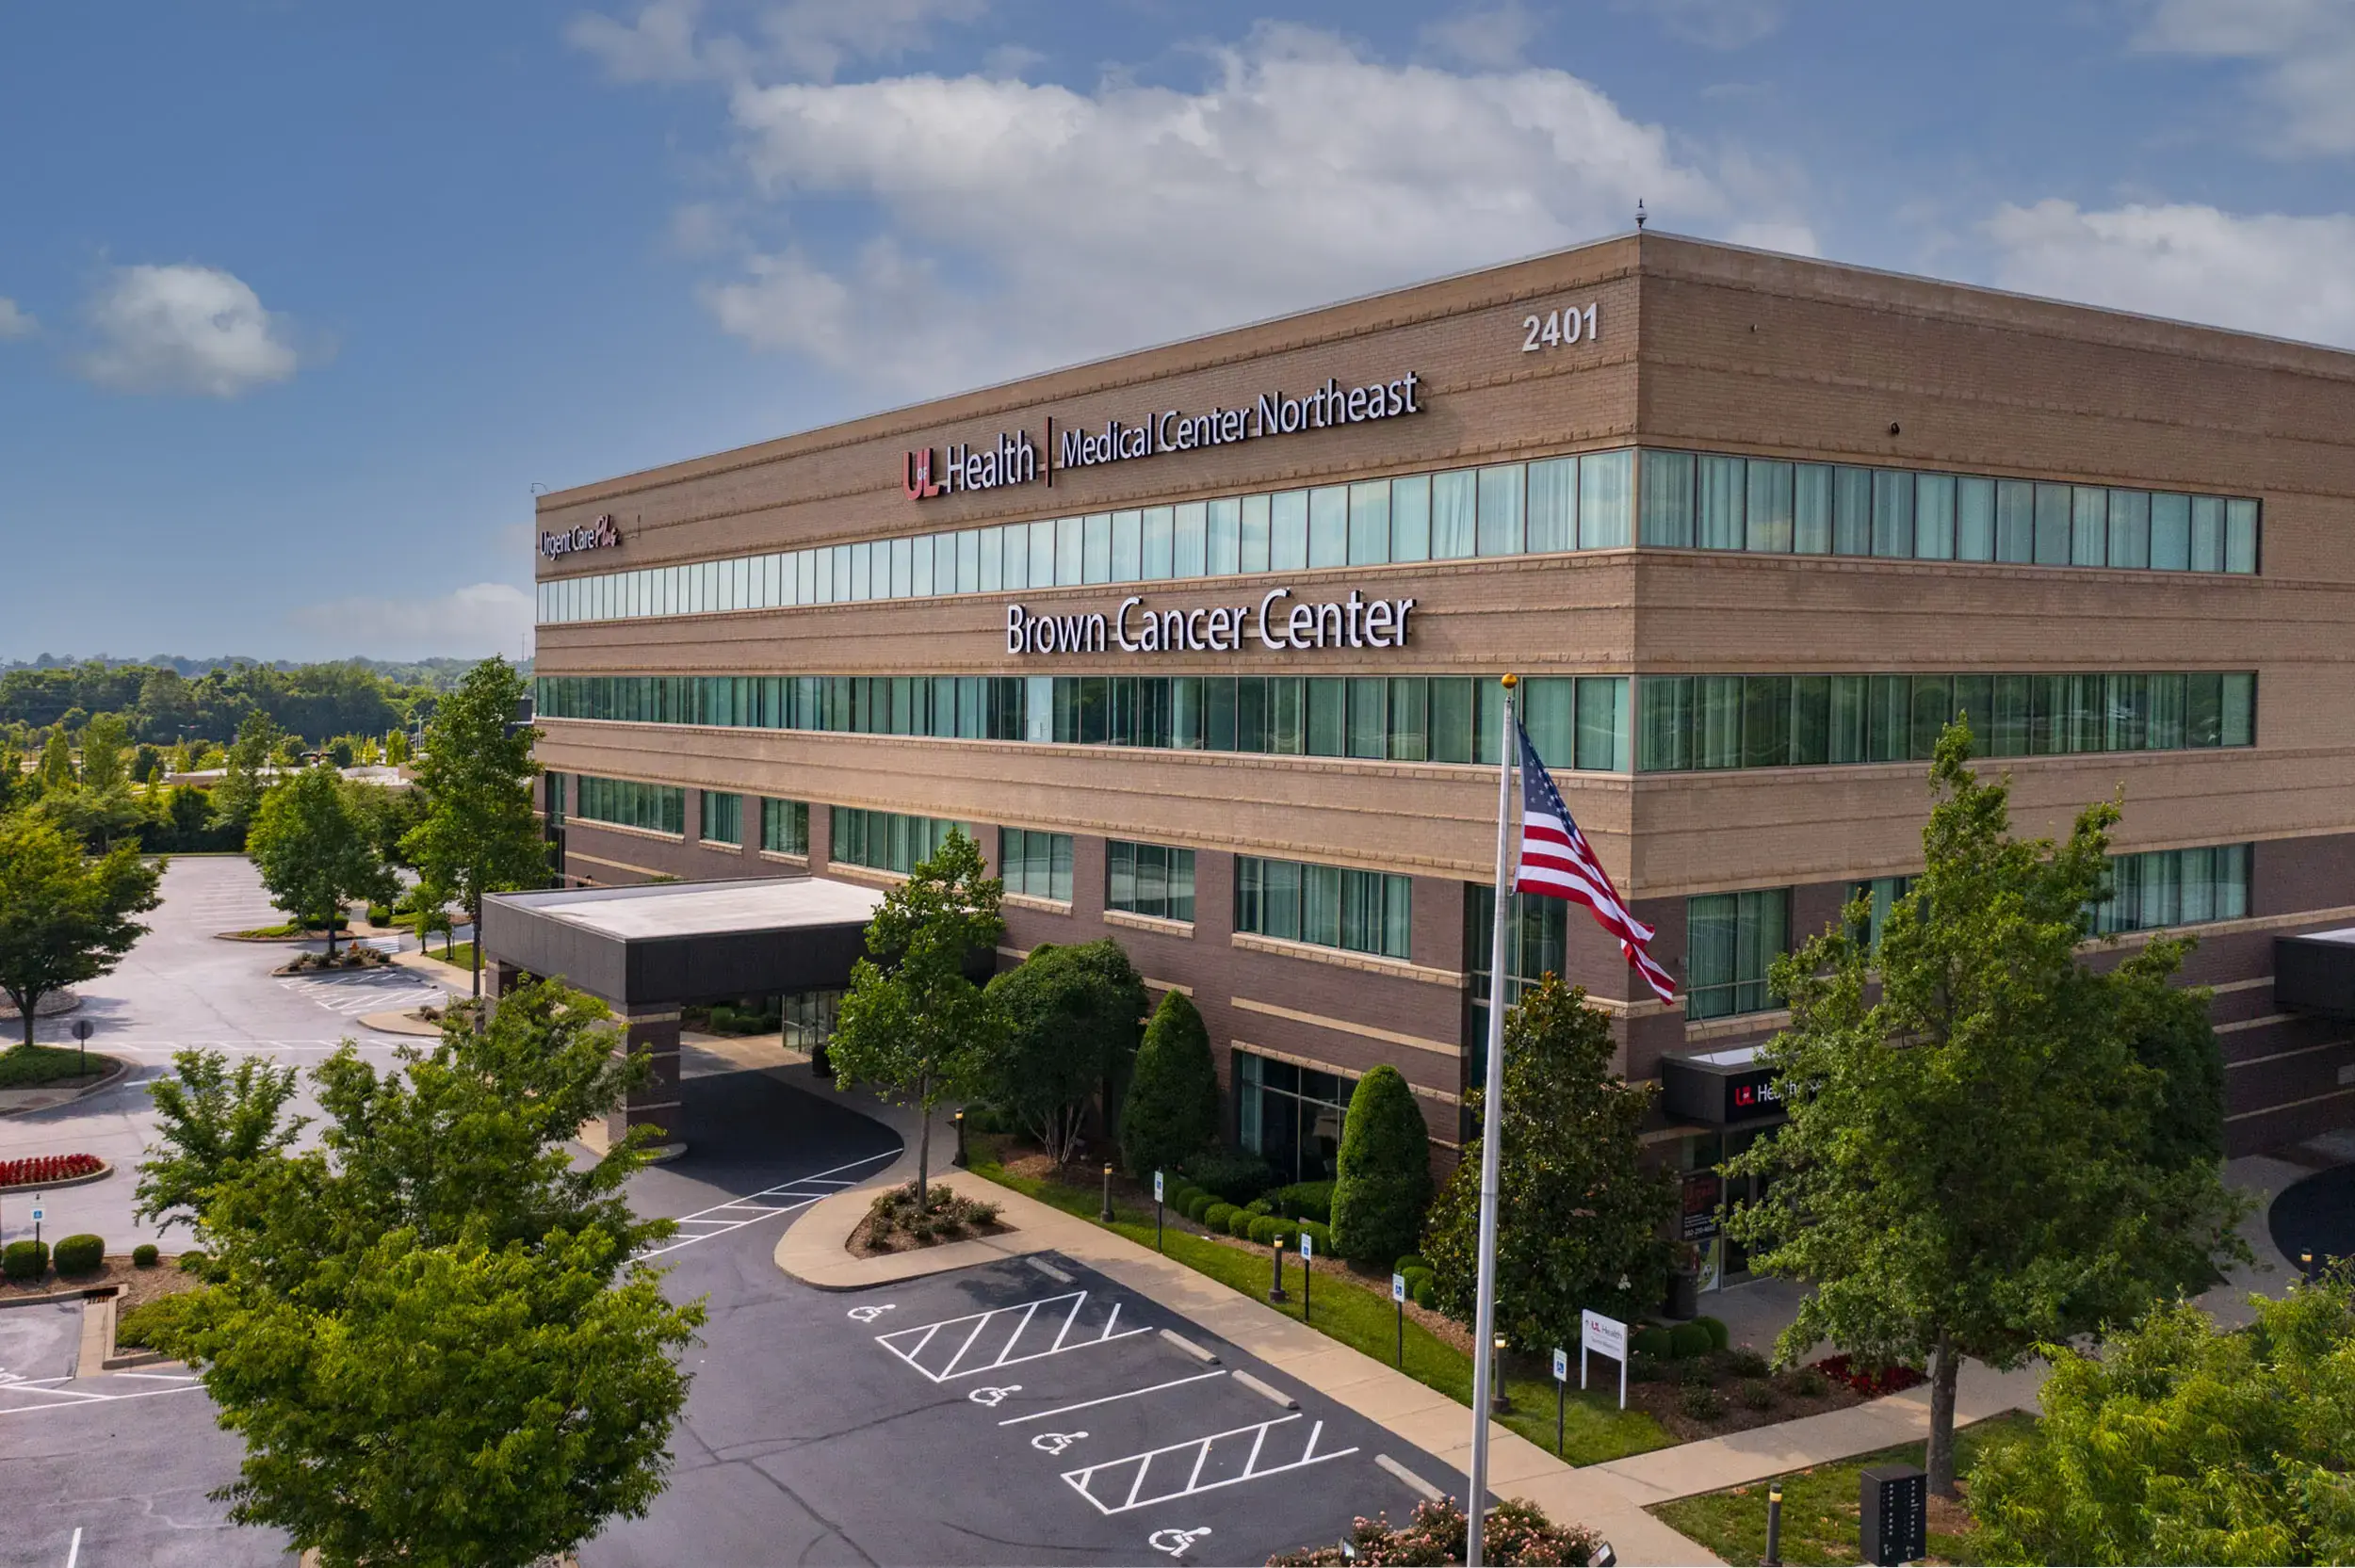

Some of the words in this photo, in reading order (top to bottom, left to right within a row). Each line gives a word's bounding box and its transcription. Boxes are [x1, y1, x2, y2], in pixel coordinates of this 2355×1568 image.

[1521, 301, 1599, 352] 2401
[947, 429, 1035, 493] Health
[1061, 414, 1155, 469] Medical
[1159, 407, 1254, 452] Center
[1258, 370, 1421, 437] Northeast
[540, 529, 572, 561] Urgent
[572, 525, 595, 551] Care
[594, 514, 619, 547] Plus
[1007, 604, 1107, 654] Brown
[1116, 596, 1251, 652] Cancer
[1259, 588, 1415, 650] Center
